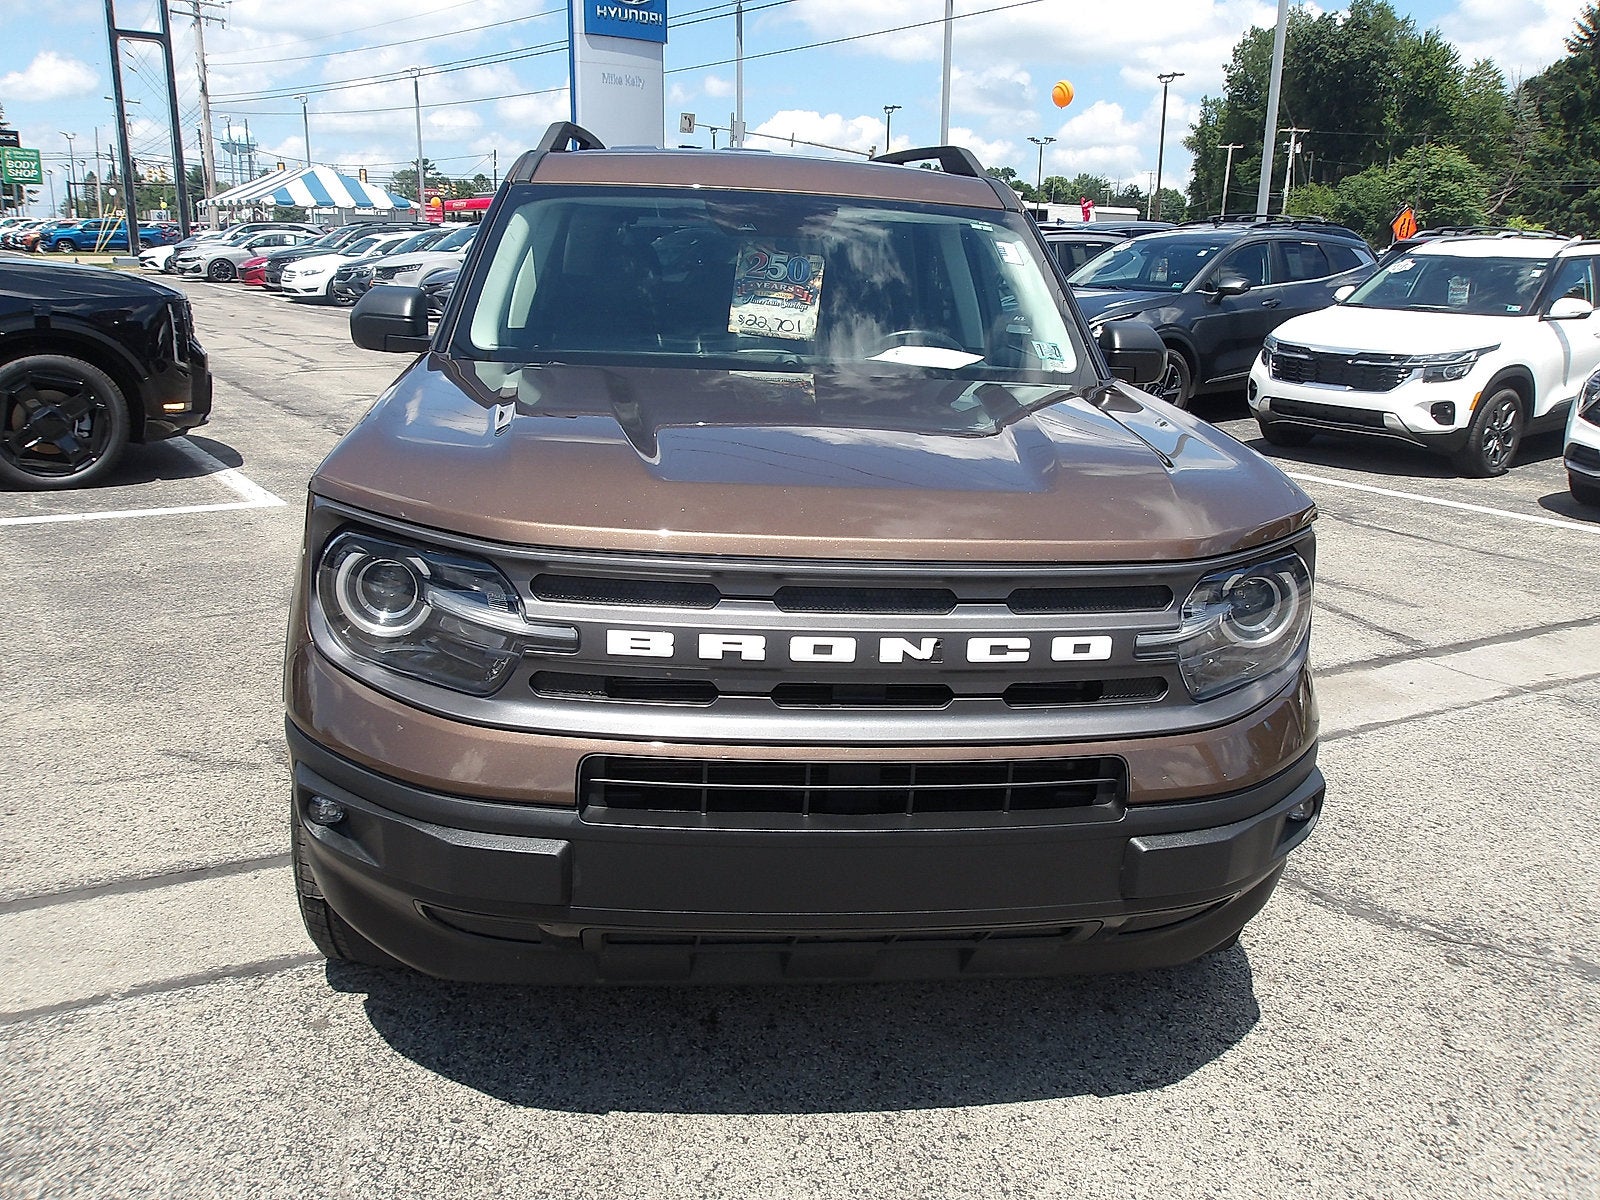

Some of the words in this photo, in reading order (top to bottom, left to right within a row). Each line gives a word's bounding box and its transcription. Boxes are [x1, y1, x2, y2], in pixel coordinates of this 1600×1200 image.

[596, 5, 663, 26] HYUNDAI
[601, 72, 623, 86] Mike
[6, 160, 37, 169] BODY
[7, 168, 38, 177] SHOP
[745, 252, 811, 284] 250
[756, 282, 795, 293] YEARS
[606, 629, 1113, 664] BRONCO
